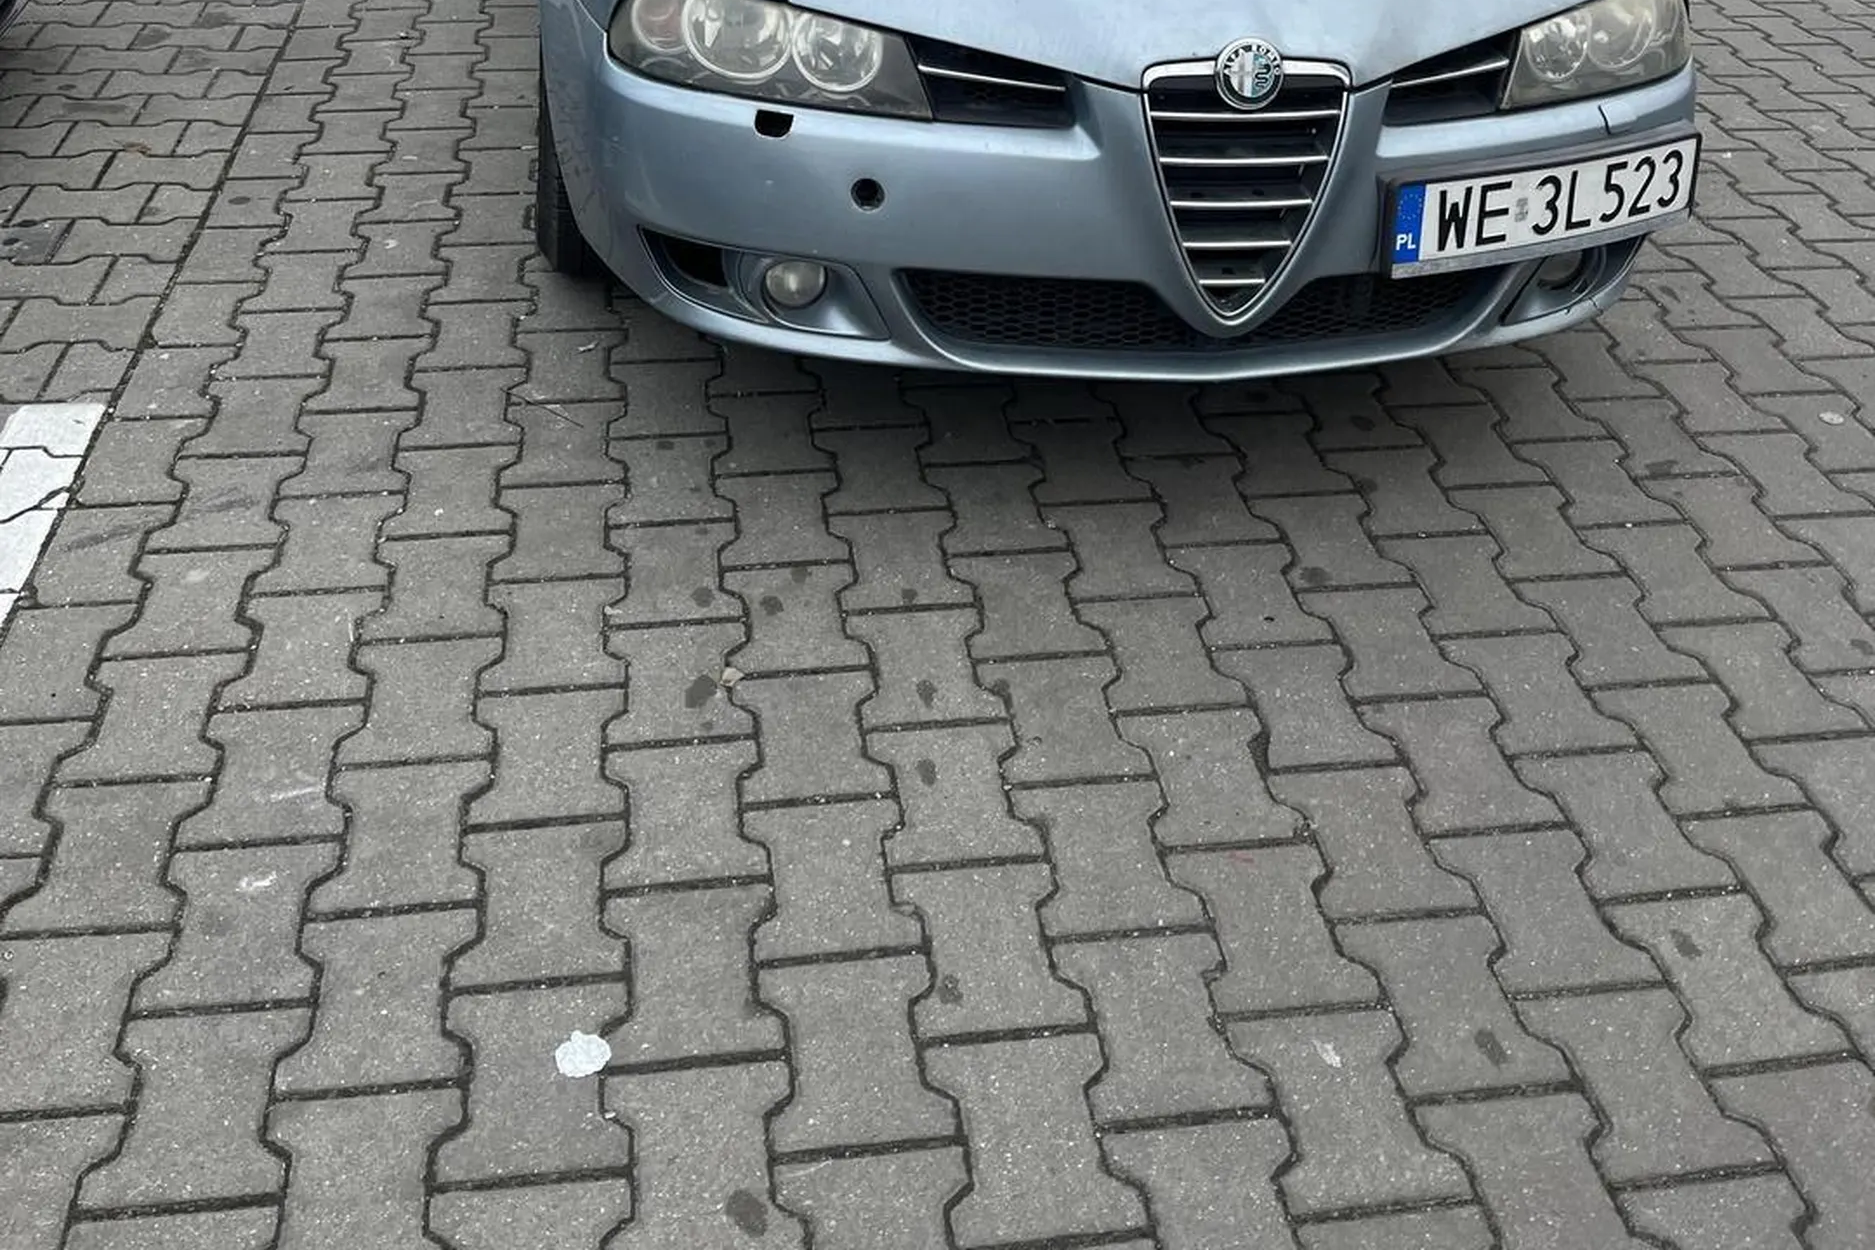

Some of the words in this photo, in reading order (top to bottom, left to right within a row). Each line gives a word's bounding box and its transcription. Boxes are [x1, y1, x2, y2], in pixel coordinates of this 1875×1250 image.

[1437, 180, 1512, 252] WE
[1531, 149, 1684, 236] 3L523
[1396, 233, 1416, 251] PL
